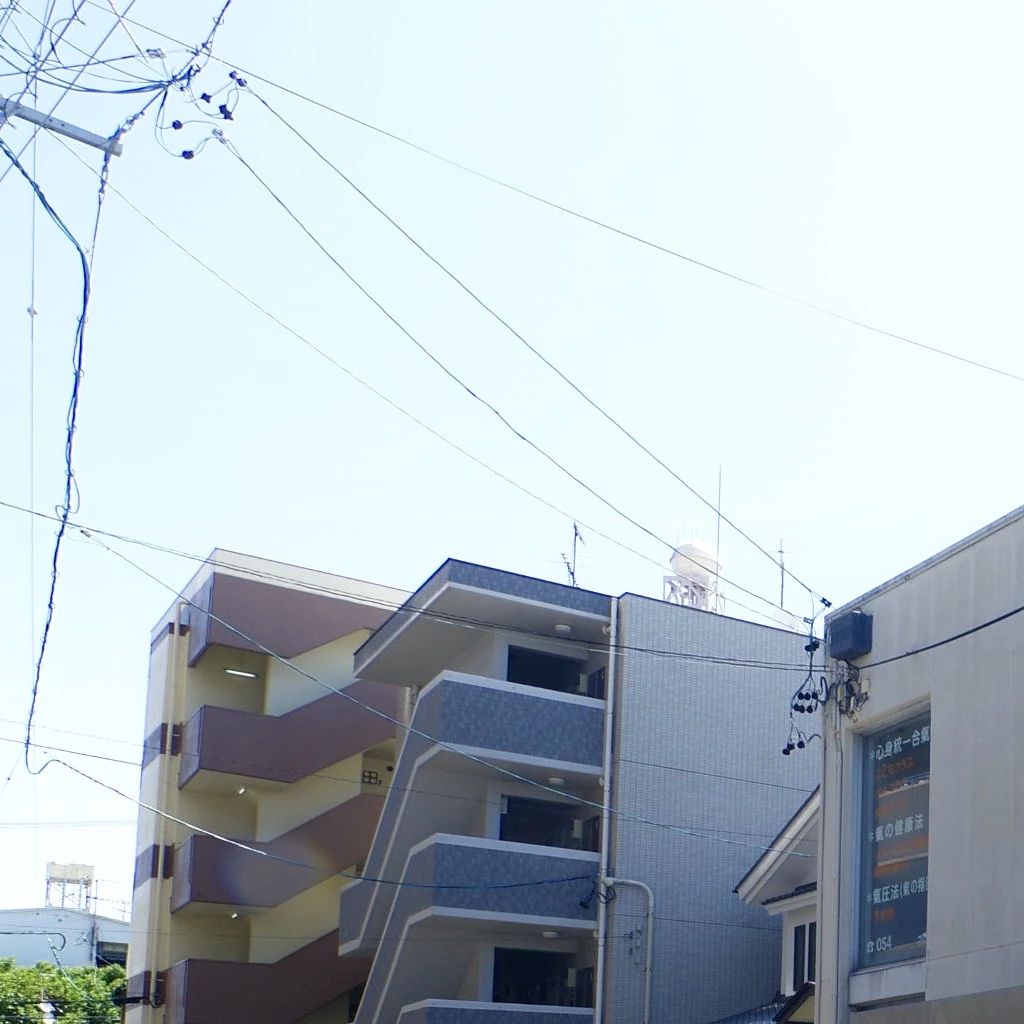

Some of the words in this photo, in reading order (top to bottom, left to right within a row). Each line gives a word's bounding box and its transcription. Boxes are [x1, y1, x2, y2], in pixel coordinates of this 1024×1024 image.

[873, 876, 928, 904] 氣圧法(氣の指
[876, 936, 892, 951] 054
